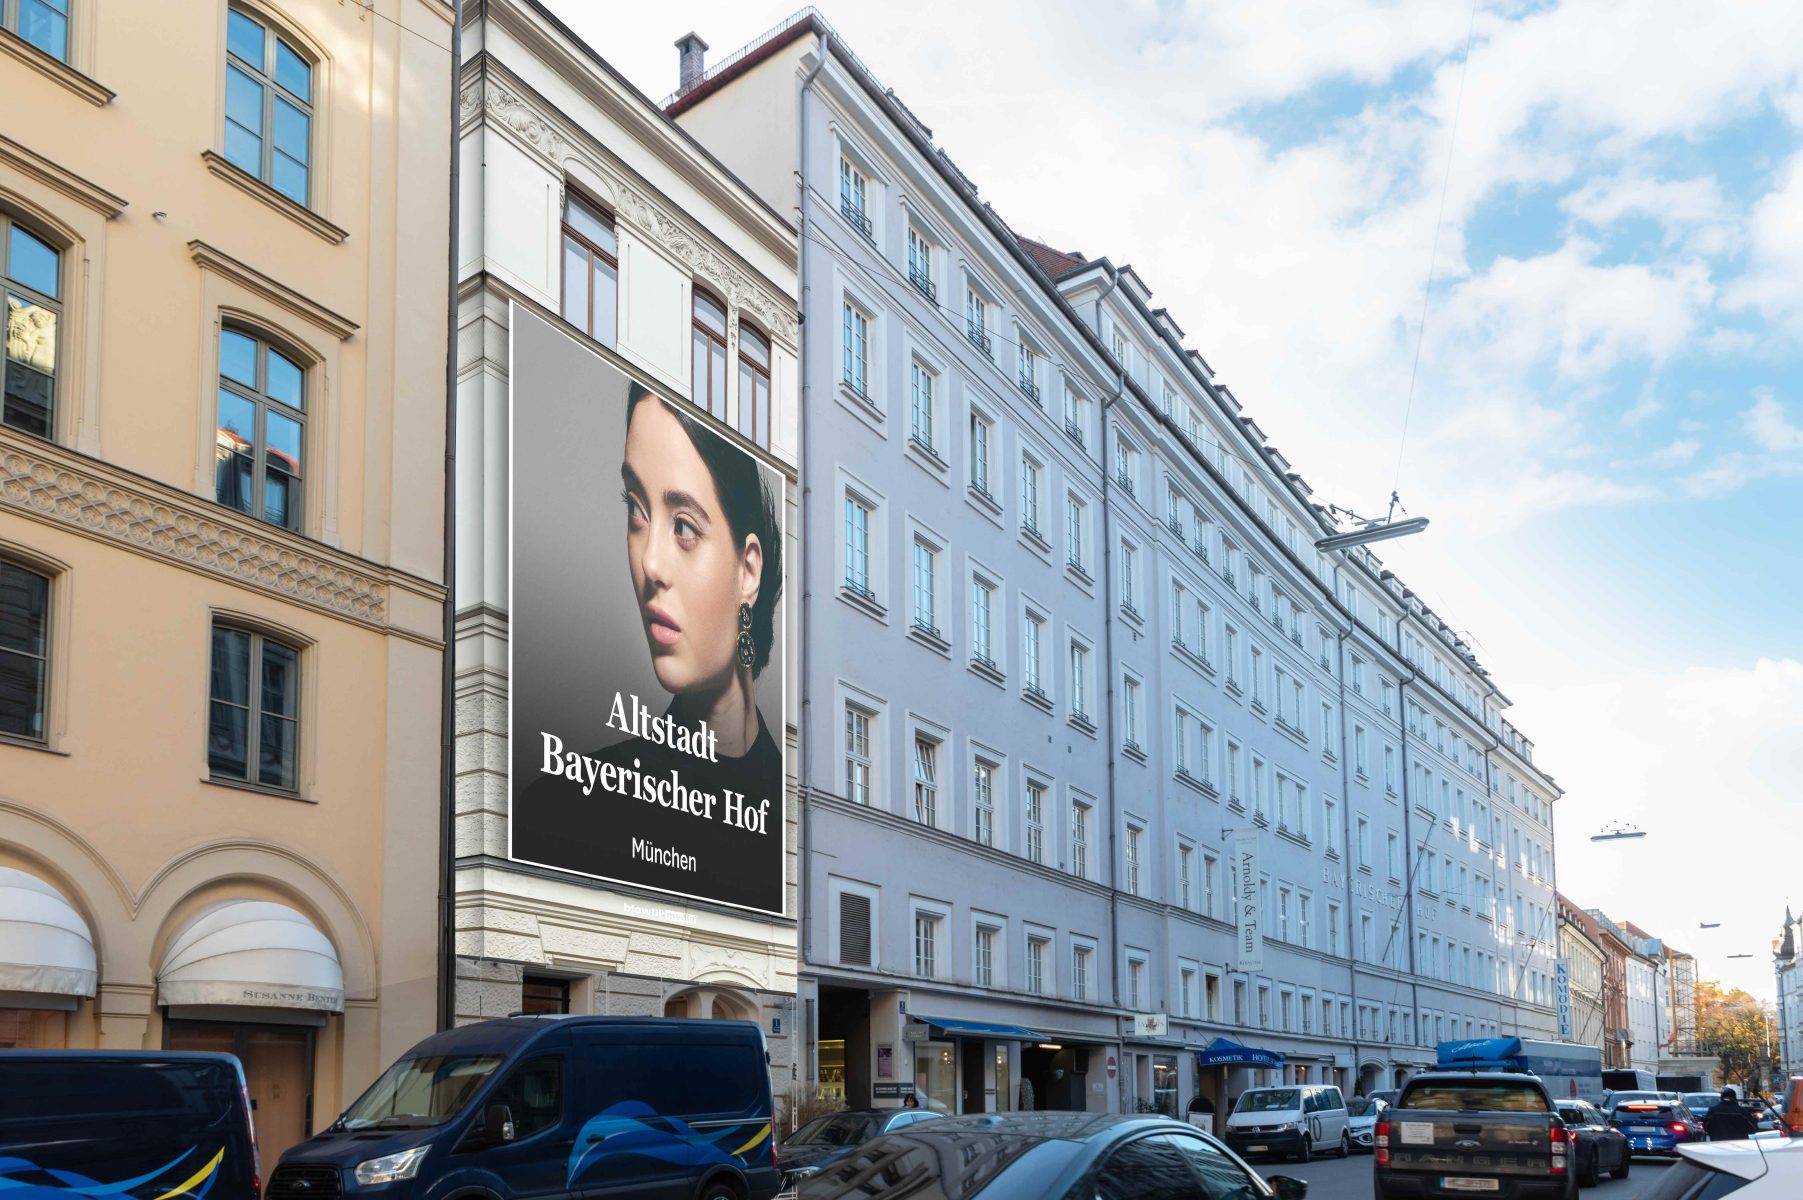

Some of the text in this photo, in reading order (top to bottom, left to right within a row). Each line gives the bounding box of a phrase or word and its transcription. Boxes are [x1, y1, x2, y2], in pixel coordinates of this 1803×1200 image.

[605, 691, 719, 763] Altstadt
[540, 731, 770, 835] Bayerischer Hof
[631, 836, 697, 873] München
[1241, 852, 1256, 901] Arnoldy
[1244, 920, 1257, 953] Team
[1209, 1054, 1243, 1063] KOSMETIK
[1394, 1152, 1546, 1168] RANGER
